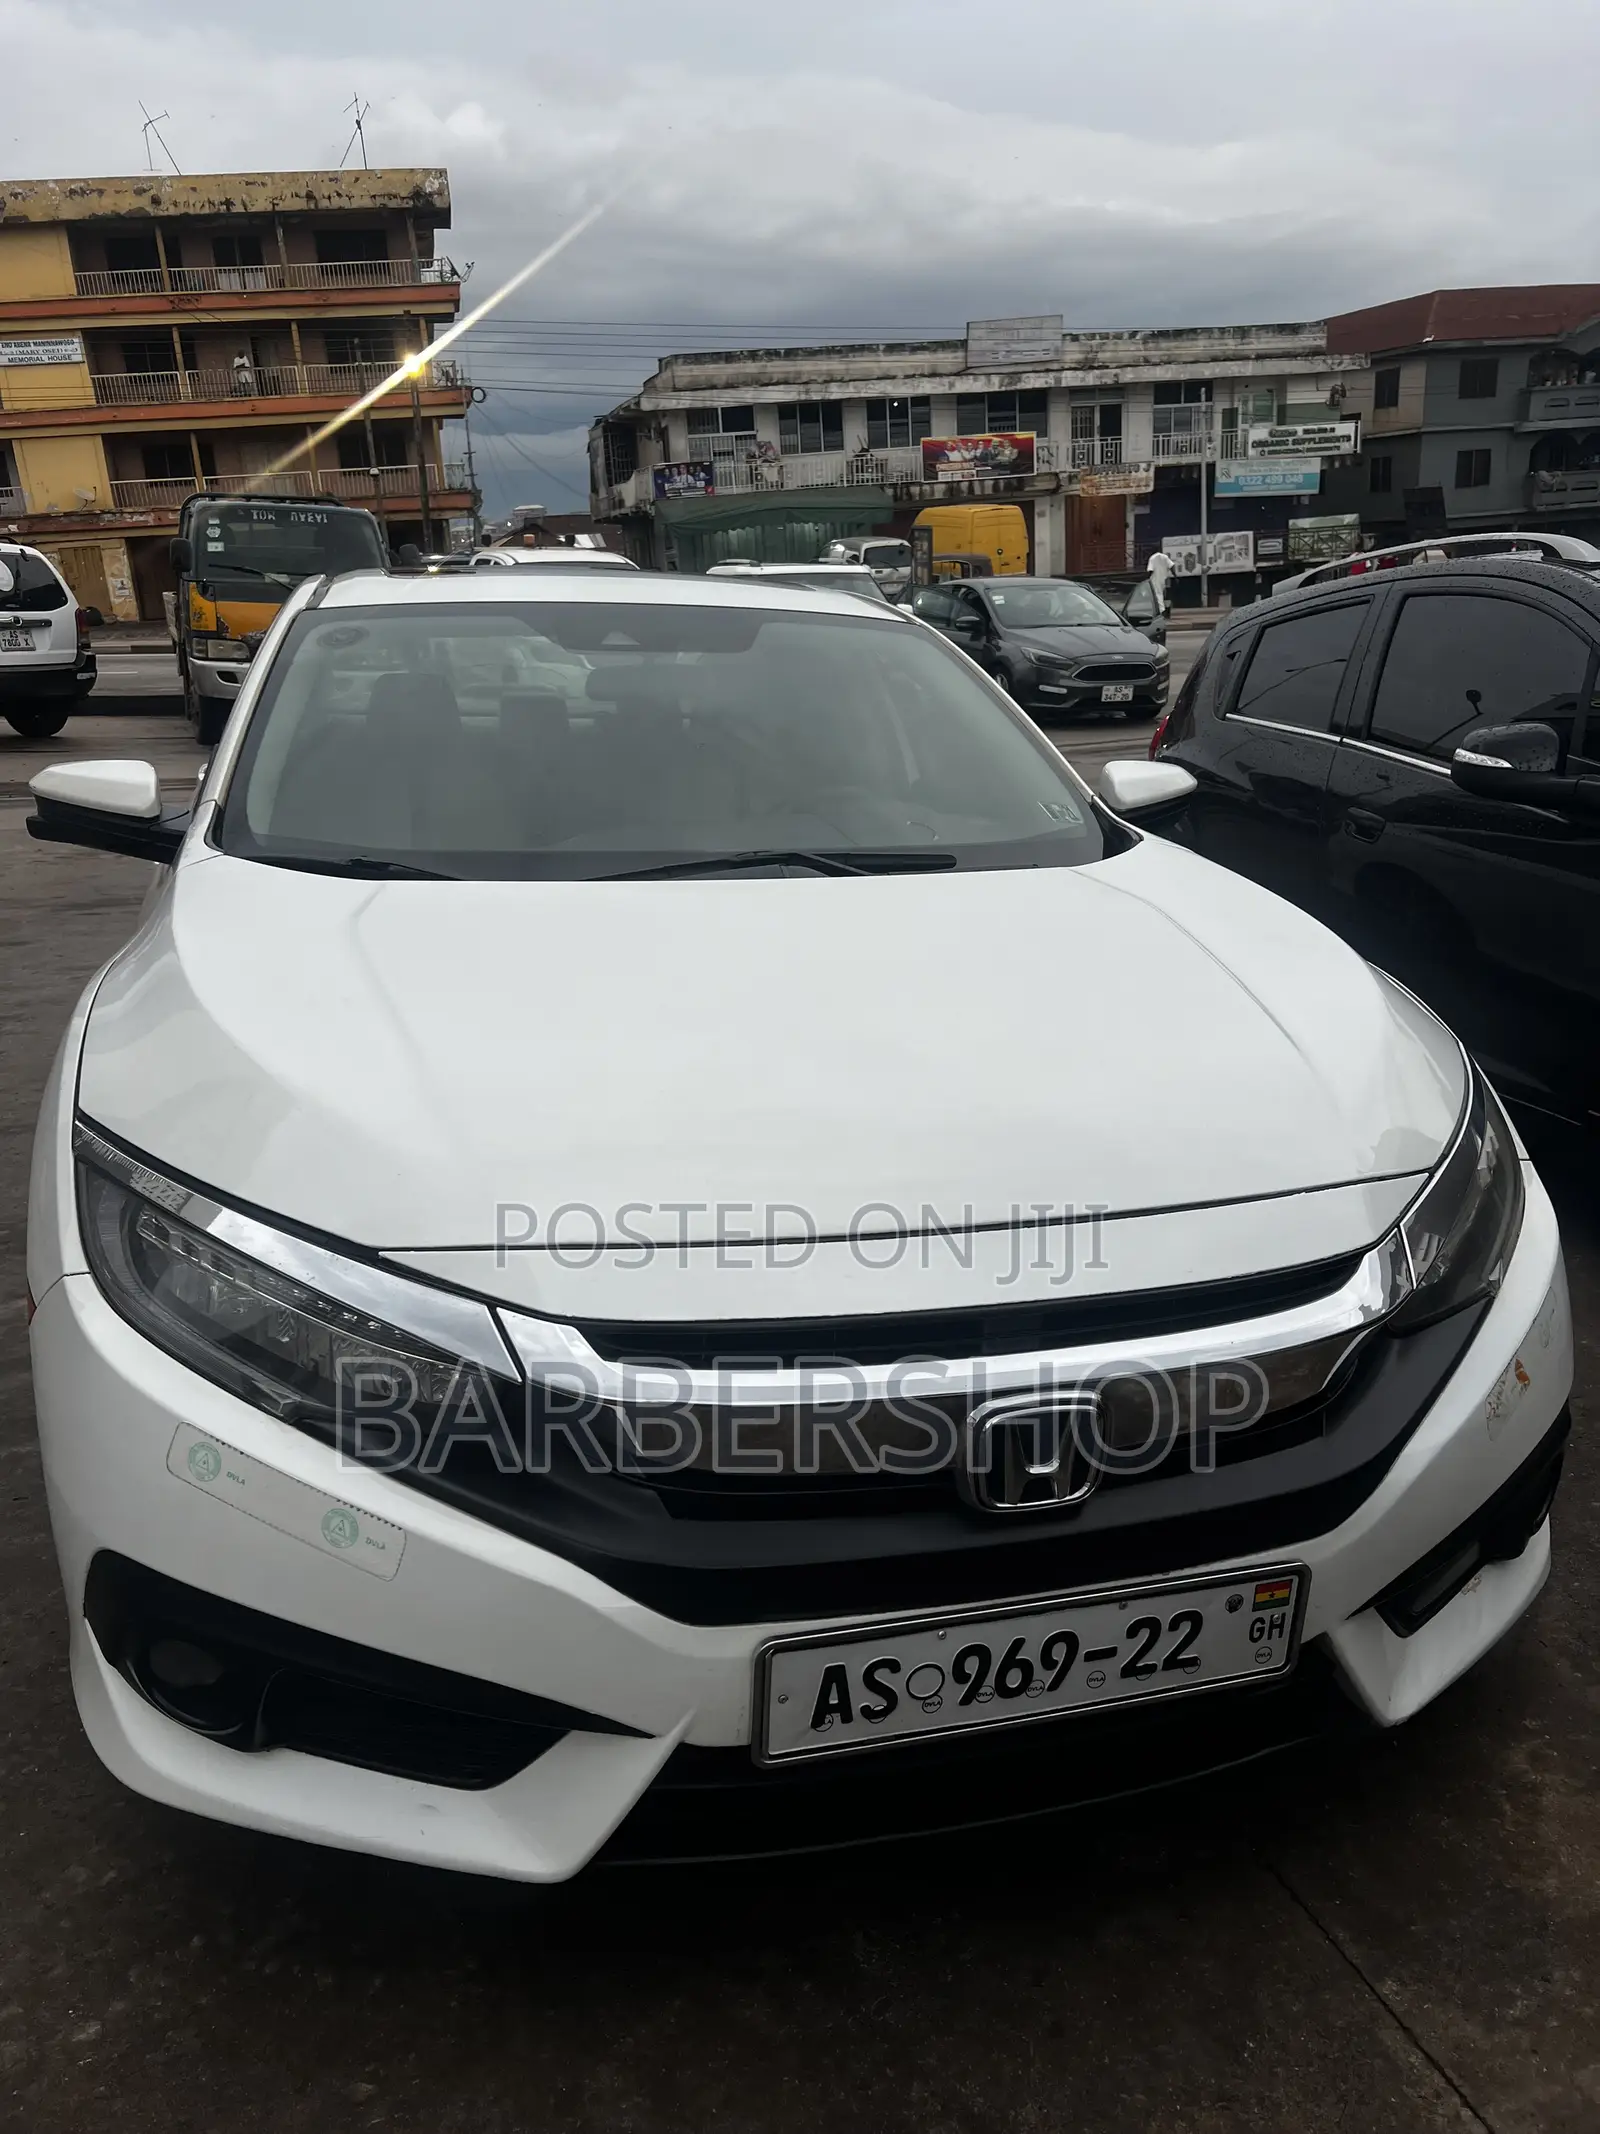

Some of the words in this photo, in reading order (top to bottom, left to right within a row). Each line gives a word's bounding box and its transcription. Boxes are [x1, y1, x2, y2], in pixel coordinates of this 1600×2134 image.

[47, 354, 73, 362] HOUSE
[1252, 438, 1290, 449] ORGANIC
[1291, 434, 1352, 446] SUPPLEMENTS
[9, 630, 19, 638] AS
[226, 1471, 246, 1486] DVLA
[365, 1537, 386, 1551] DVLA
[1249, 1612, 1286, 1643] GH
[811, 1658, 902, 1728] AS
[952, 1609, 1204, 1706] 969-22
